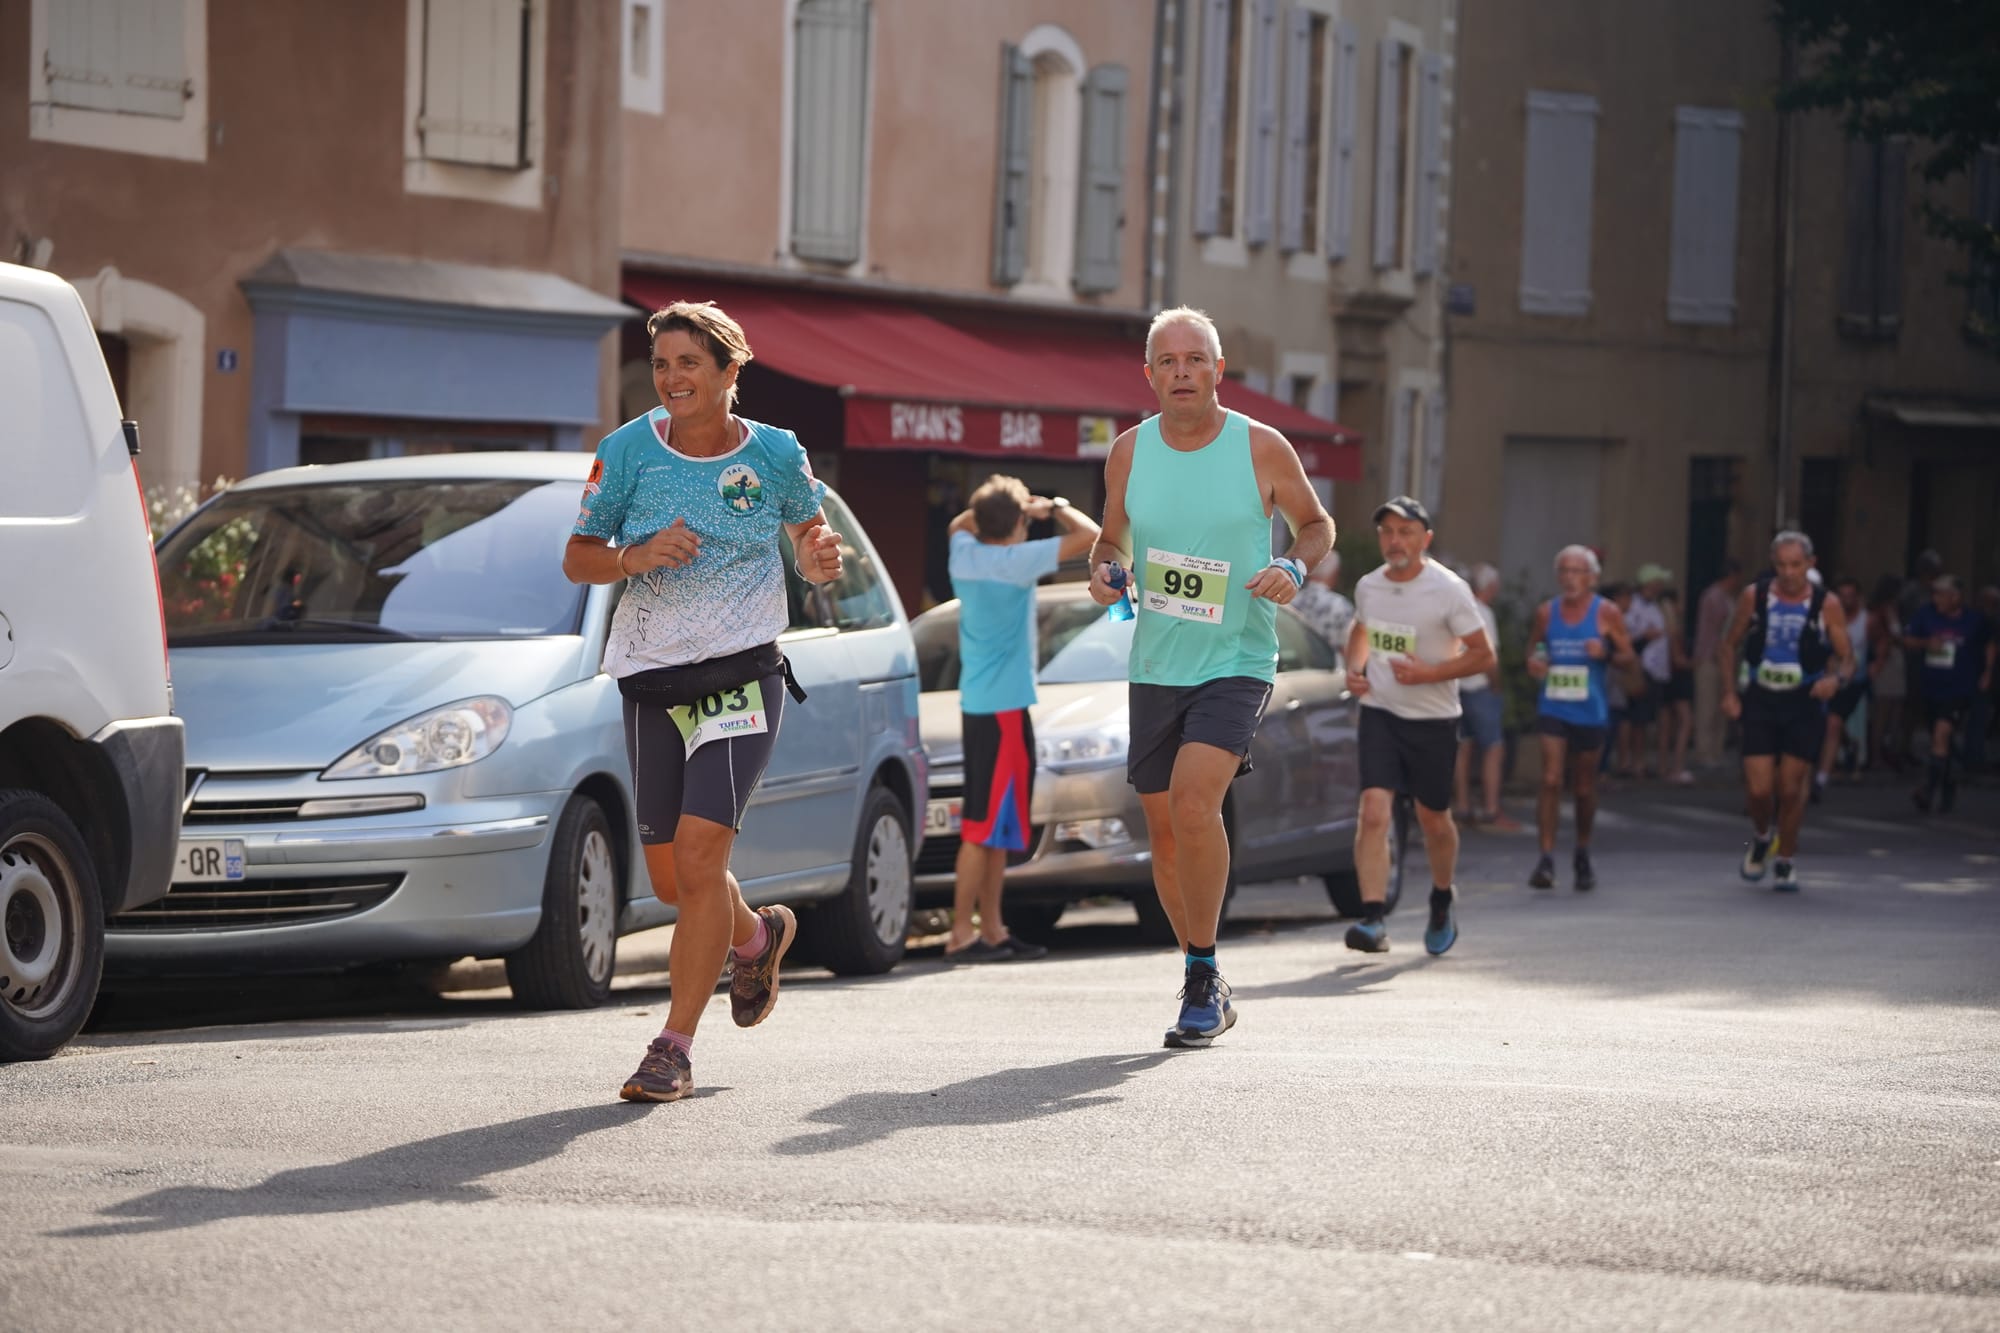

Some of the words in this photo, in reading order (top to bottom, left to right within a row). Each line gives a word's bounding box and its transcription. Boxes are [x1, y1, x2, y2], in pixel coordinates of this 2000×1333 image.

[891, 403, 964, 441] RYAN'S
[1000, 411, 1043, 447] BAR
[1164, 570, 1203, 599] 99
[1181, 604, 1206, 614] TUFF'S
[1373, 631, 1406, 652] 188
[718, 719, 748, 729] TUFF'S
